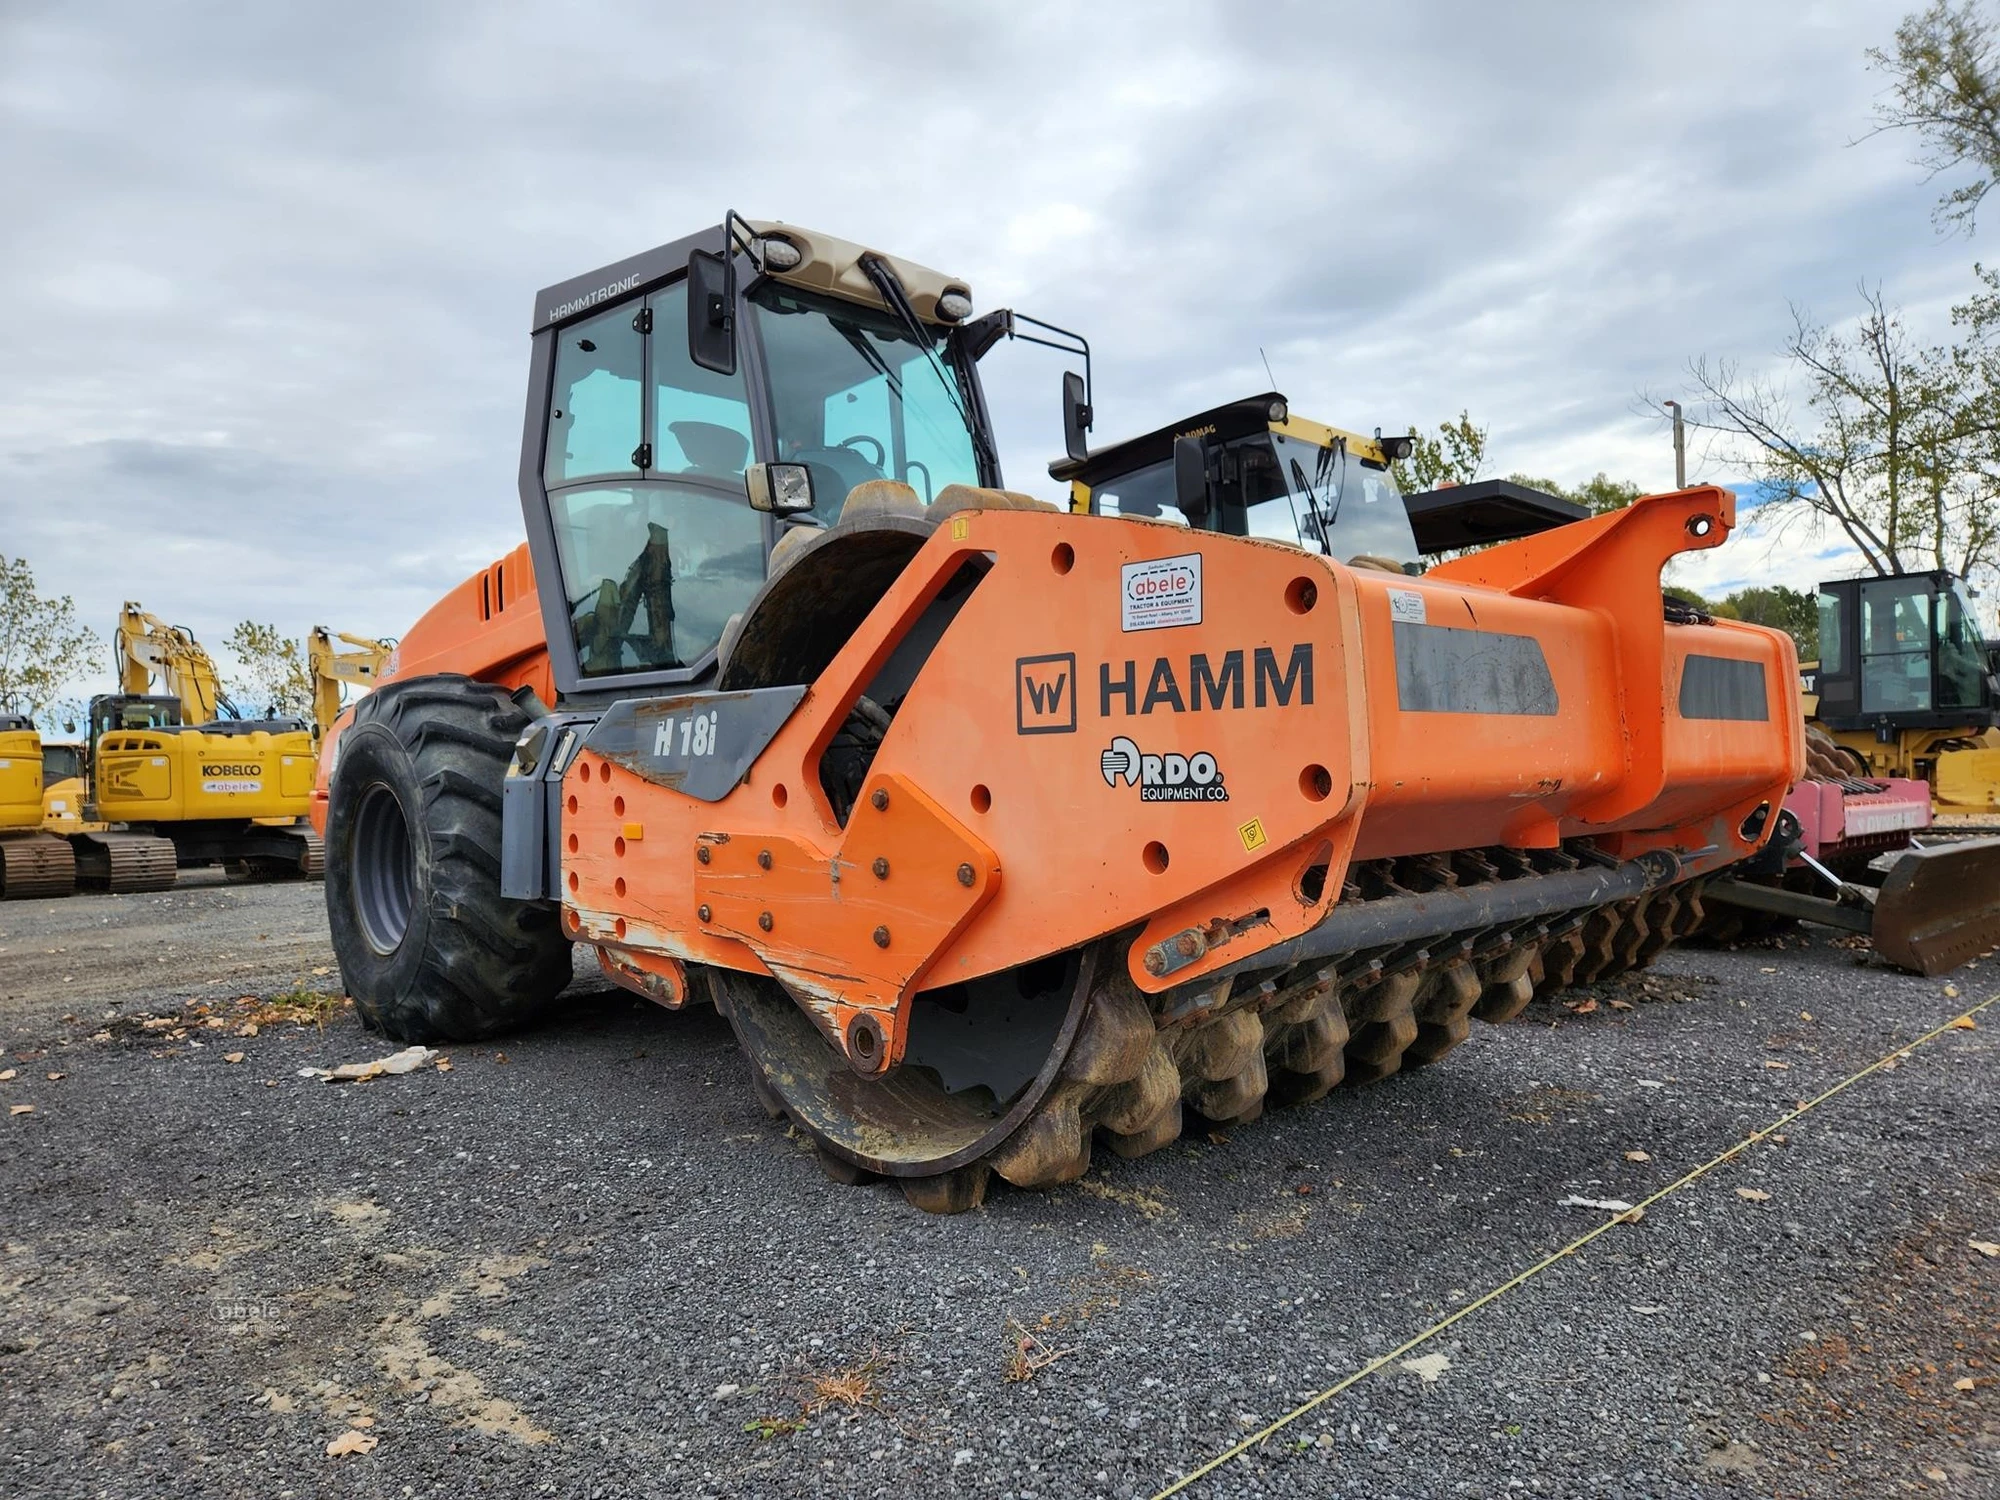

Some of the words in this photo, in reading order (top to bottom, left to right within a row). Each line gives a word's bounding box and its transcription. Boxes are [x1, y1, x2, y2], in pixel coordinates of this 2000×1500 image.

[550, 273, 640, 321] HAMMTRONIC
[1135, 574, 1186, 596] abele
[1129, 602, 1154, 610] TRACTOR
[1160, 598, 1193, 607] EQUIPMENT
[1100, 643, 1314, 717] HAMM
[653, 717, 674, 757] H
[680, 710, 718, 757] 18i
[202, 765, 262, 777] KOBELCO
[217, 783, 249, 791] abele
[1142, 787, 1205, 800] EQUIPMENT
[1206, 786, 1228, 800] CO.
